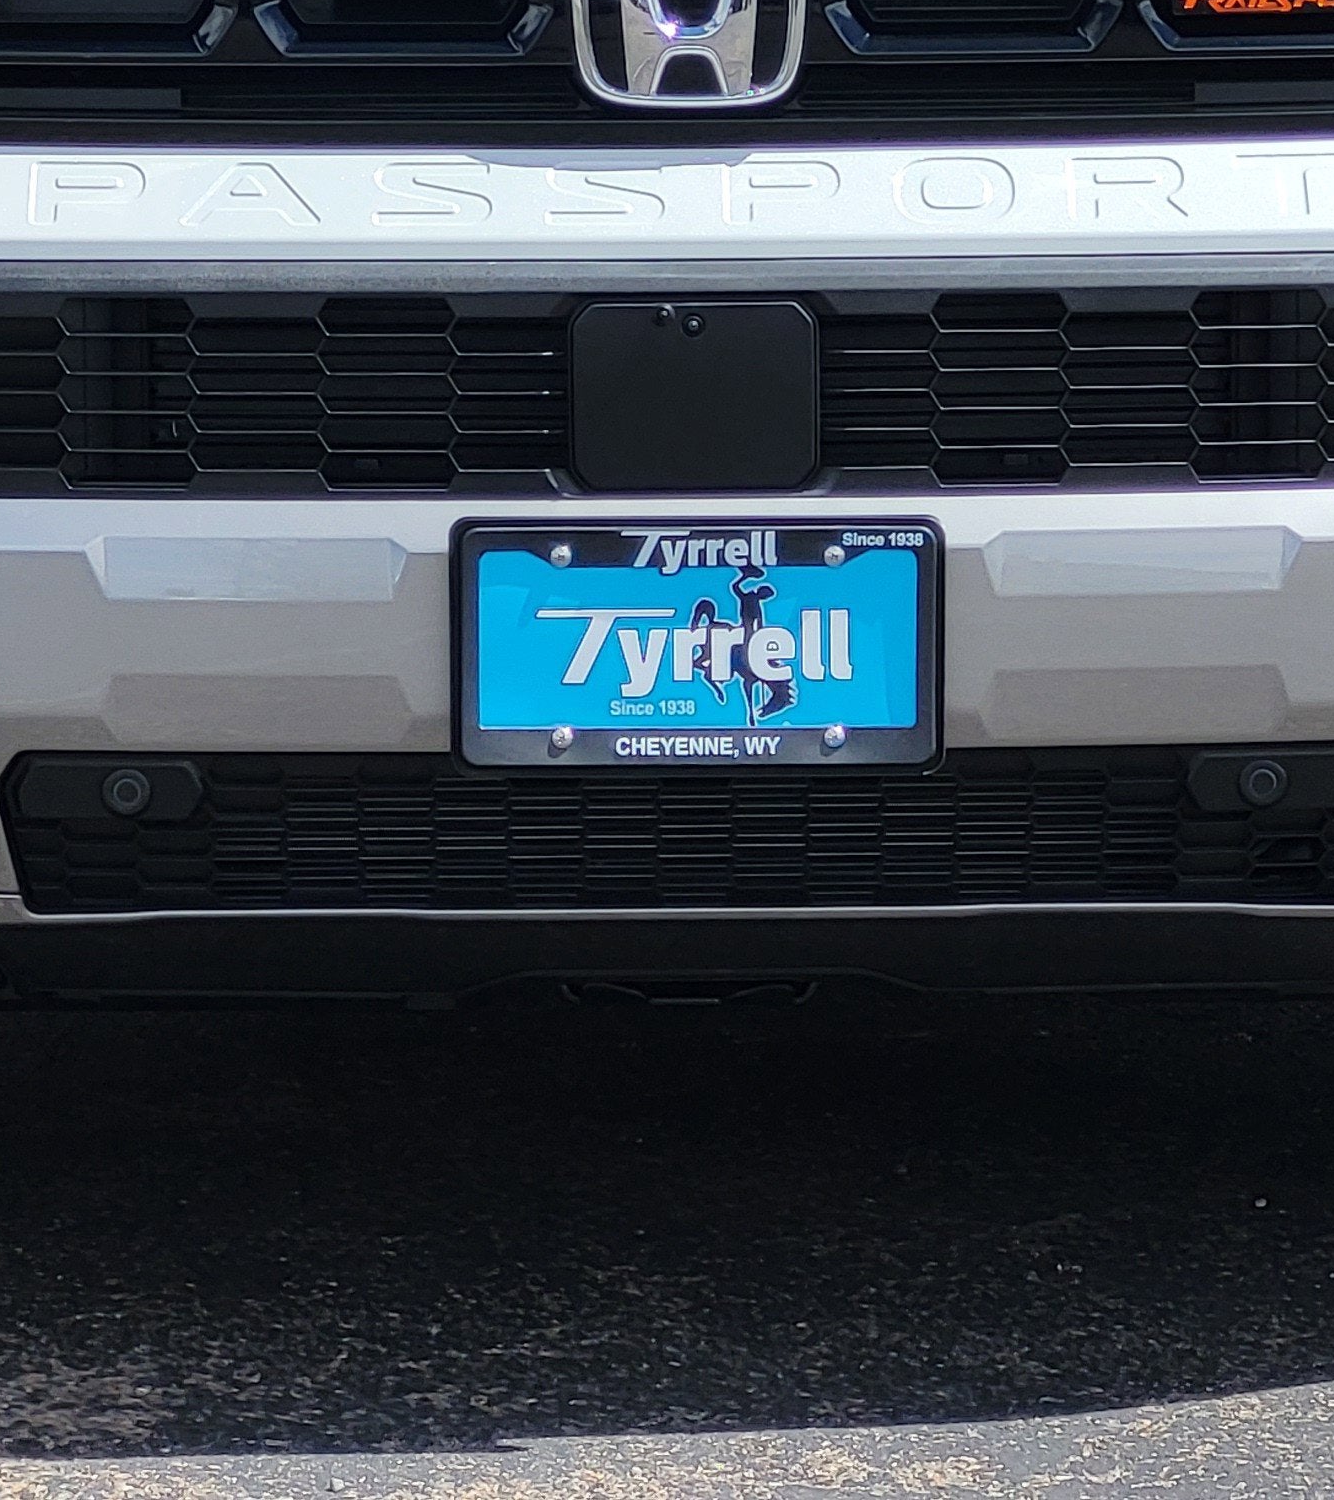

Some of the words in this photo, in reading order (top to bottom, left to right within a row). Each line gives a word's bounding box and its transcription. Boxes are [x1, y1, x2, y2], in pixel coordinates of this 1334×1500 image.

[842, 532, 885, 548] Since
[888, 532, 924, 548] 1938
[620, 530, 779, 575] Tyrrell
[535, 608, 855, 698] Tyrrell
[610, 699, 655, 717] Since
[658, 699, 696, 717] 1938
[615, 736, 740, 760] CHEYENNE,
[744, 736, 782, 757] WY
